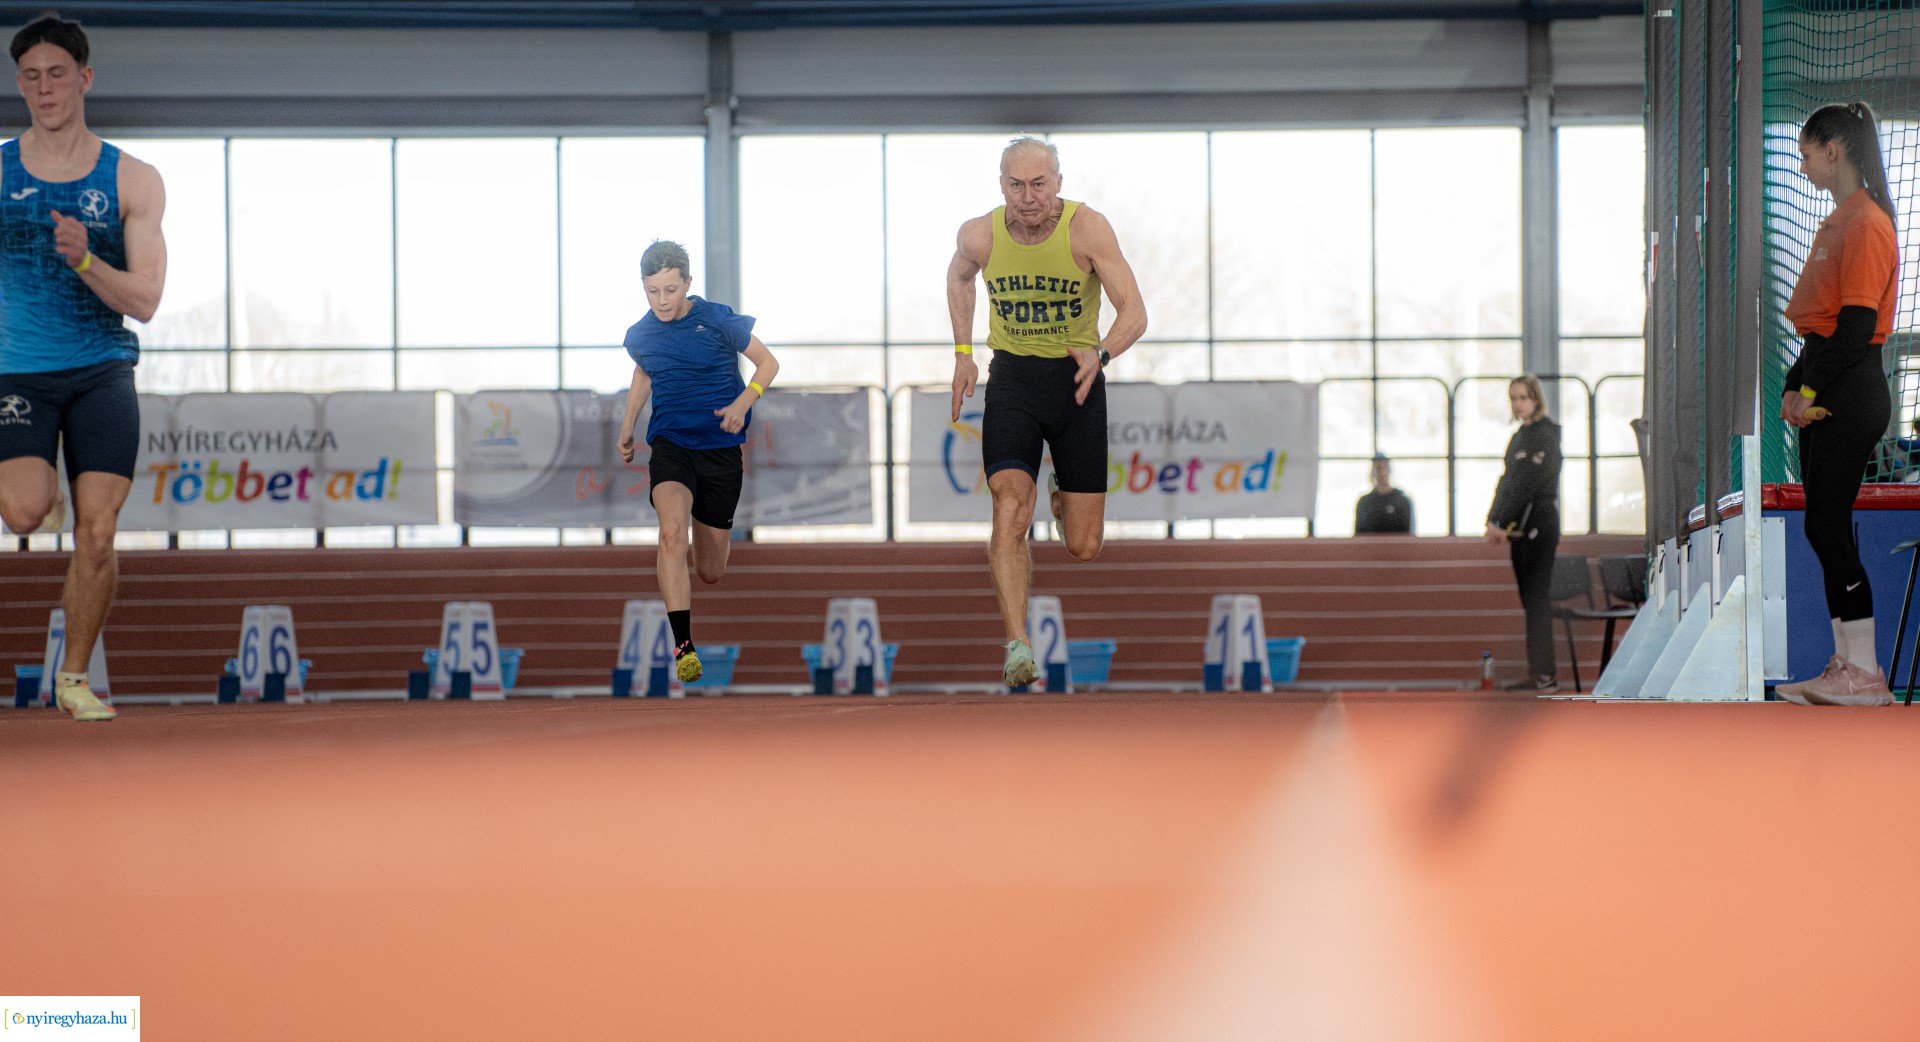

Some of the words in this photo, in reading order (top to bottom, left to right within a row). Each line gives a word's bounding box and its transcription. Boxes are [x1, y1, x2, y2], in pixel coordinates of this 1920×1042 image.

[987, 275, 1080, 295] ATHLETIC
[991, 298, 1082, 323] SPORTS
[1003, 325, 1069, 336] PERFORMANCE
[148, 425, 338, 453] NYÍREGYHÁZA
[1109, 418, 1227, 444] EGYHÁZA
[148, 457, 313, 503] Többet
[326, 456, 402, 501] ad!
[1107, 451, 1202, 495] bbet
[1213, 449, 1287, 494] ad!
